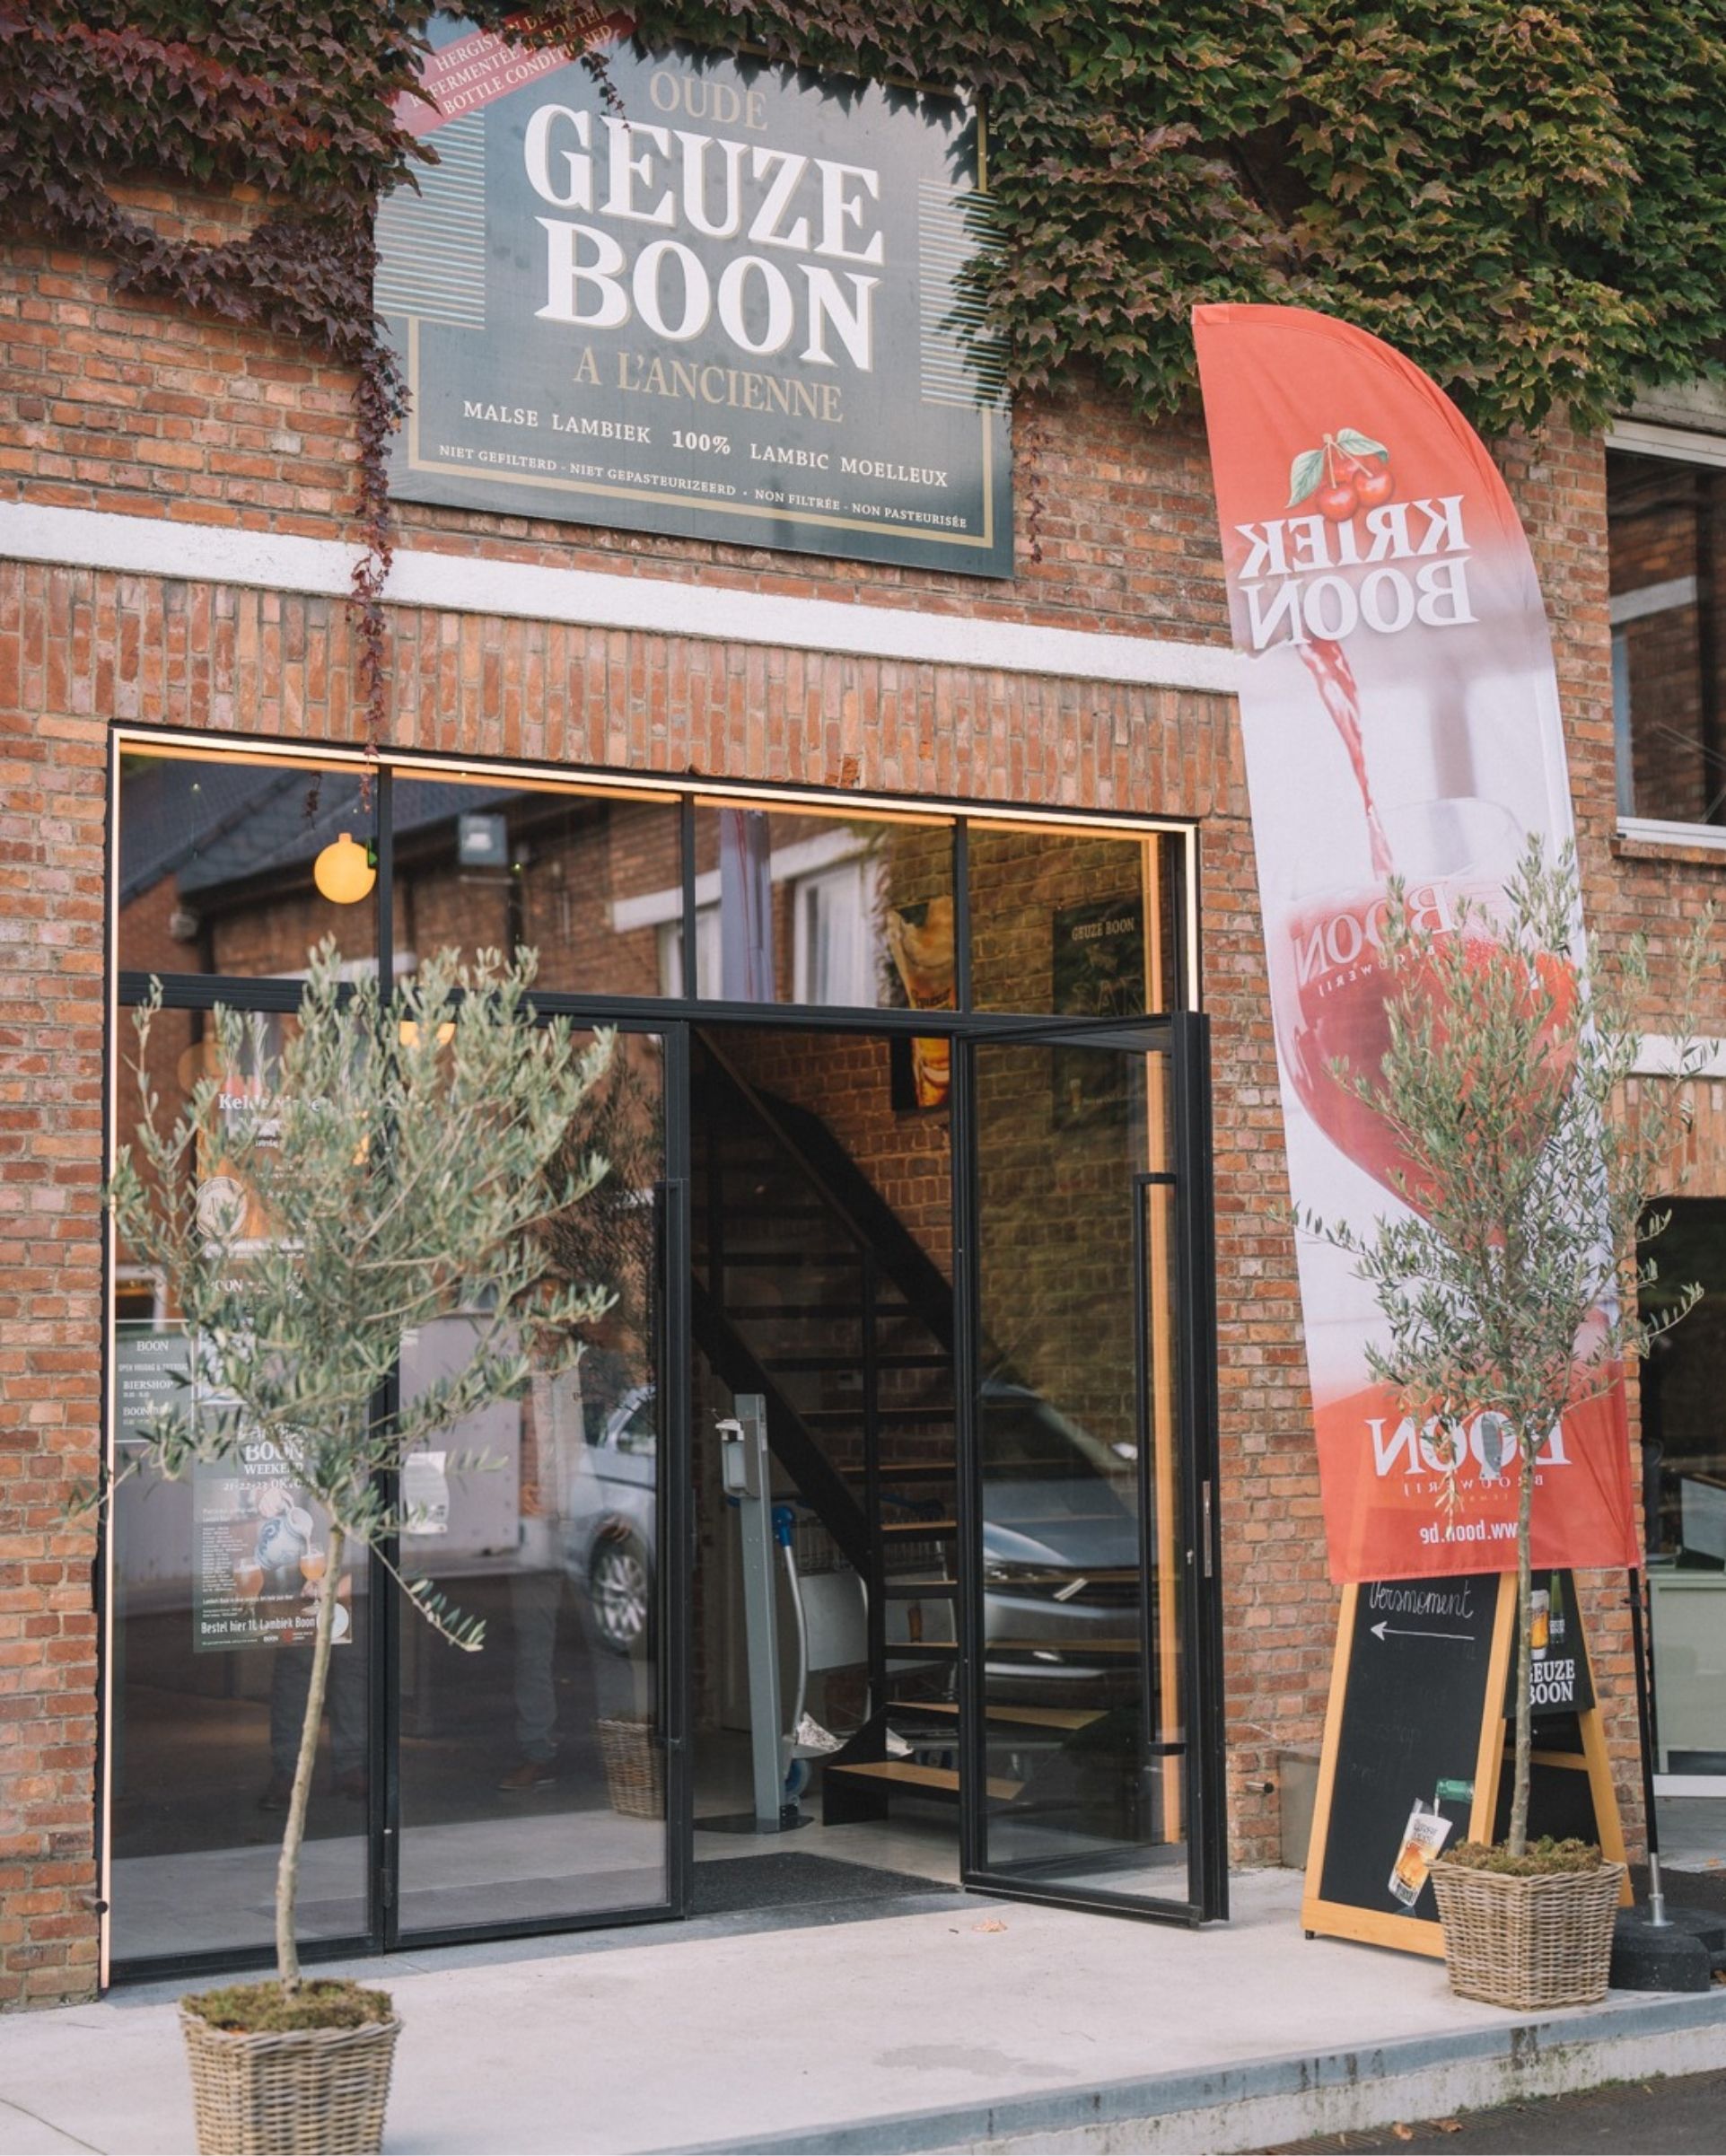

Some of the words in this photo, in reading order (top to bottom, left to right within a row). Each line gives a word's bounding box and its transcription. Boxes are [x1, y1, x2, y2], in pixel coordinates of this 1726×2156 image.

[409, 46, 521, 109] RFERMENTÉE
[442, 76, 504, 115] BOTTLE
[505, 24, 612, 84] CONDITINED
[649, 71, 768, 130] OUDE
[523, 103, 886, 266] GEUZE
[534, 215, 884, 373] BOON
[573, 346, 602, 385] A
[462, 400, 539, 427] MALSE
[552, 413, 651, 443] LAMBIEK
[672, 430, 731, 455] 100%
[750, 443, 828, 469] LAMBIC
[839, 457, 948, 487] MOELLEUX
[439, 445, 474, 459] NIET
[478, 451, 556, 471] GEFILTERD
[569, 463, 603, 478] NIET
[608, 469, 736, 495] GEPASTEURIZEERD
[755, 489, 784, 503] NON
[789, 494, 839, 511] FILTRÉE
[852, 503, 881, 516] NON
[884, 507, 967, 529] PASTEURISÉE
[1072, 922, 1103, 941] GEUZE
[1105, 917, 1135, 935] BOON
[136, 1340, 169, 1352] BOON
[123, 1380, 173, 1390] BIERSHOP
[244, 1462, 303, 1475] WEEKED
[201, 1621, 228, 1635] Bestel
[230, 1619, 246, 1633] hier
[259, 1617, 294, 1631] Lambiek
[294, 1616, 315, 1628] Boon
[1529, 1659, 1575, 1684] EUZE
[1529, 1681, 1573, 1705] BOON
